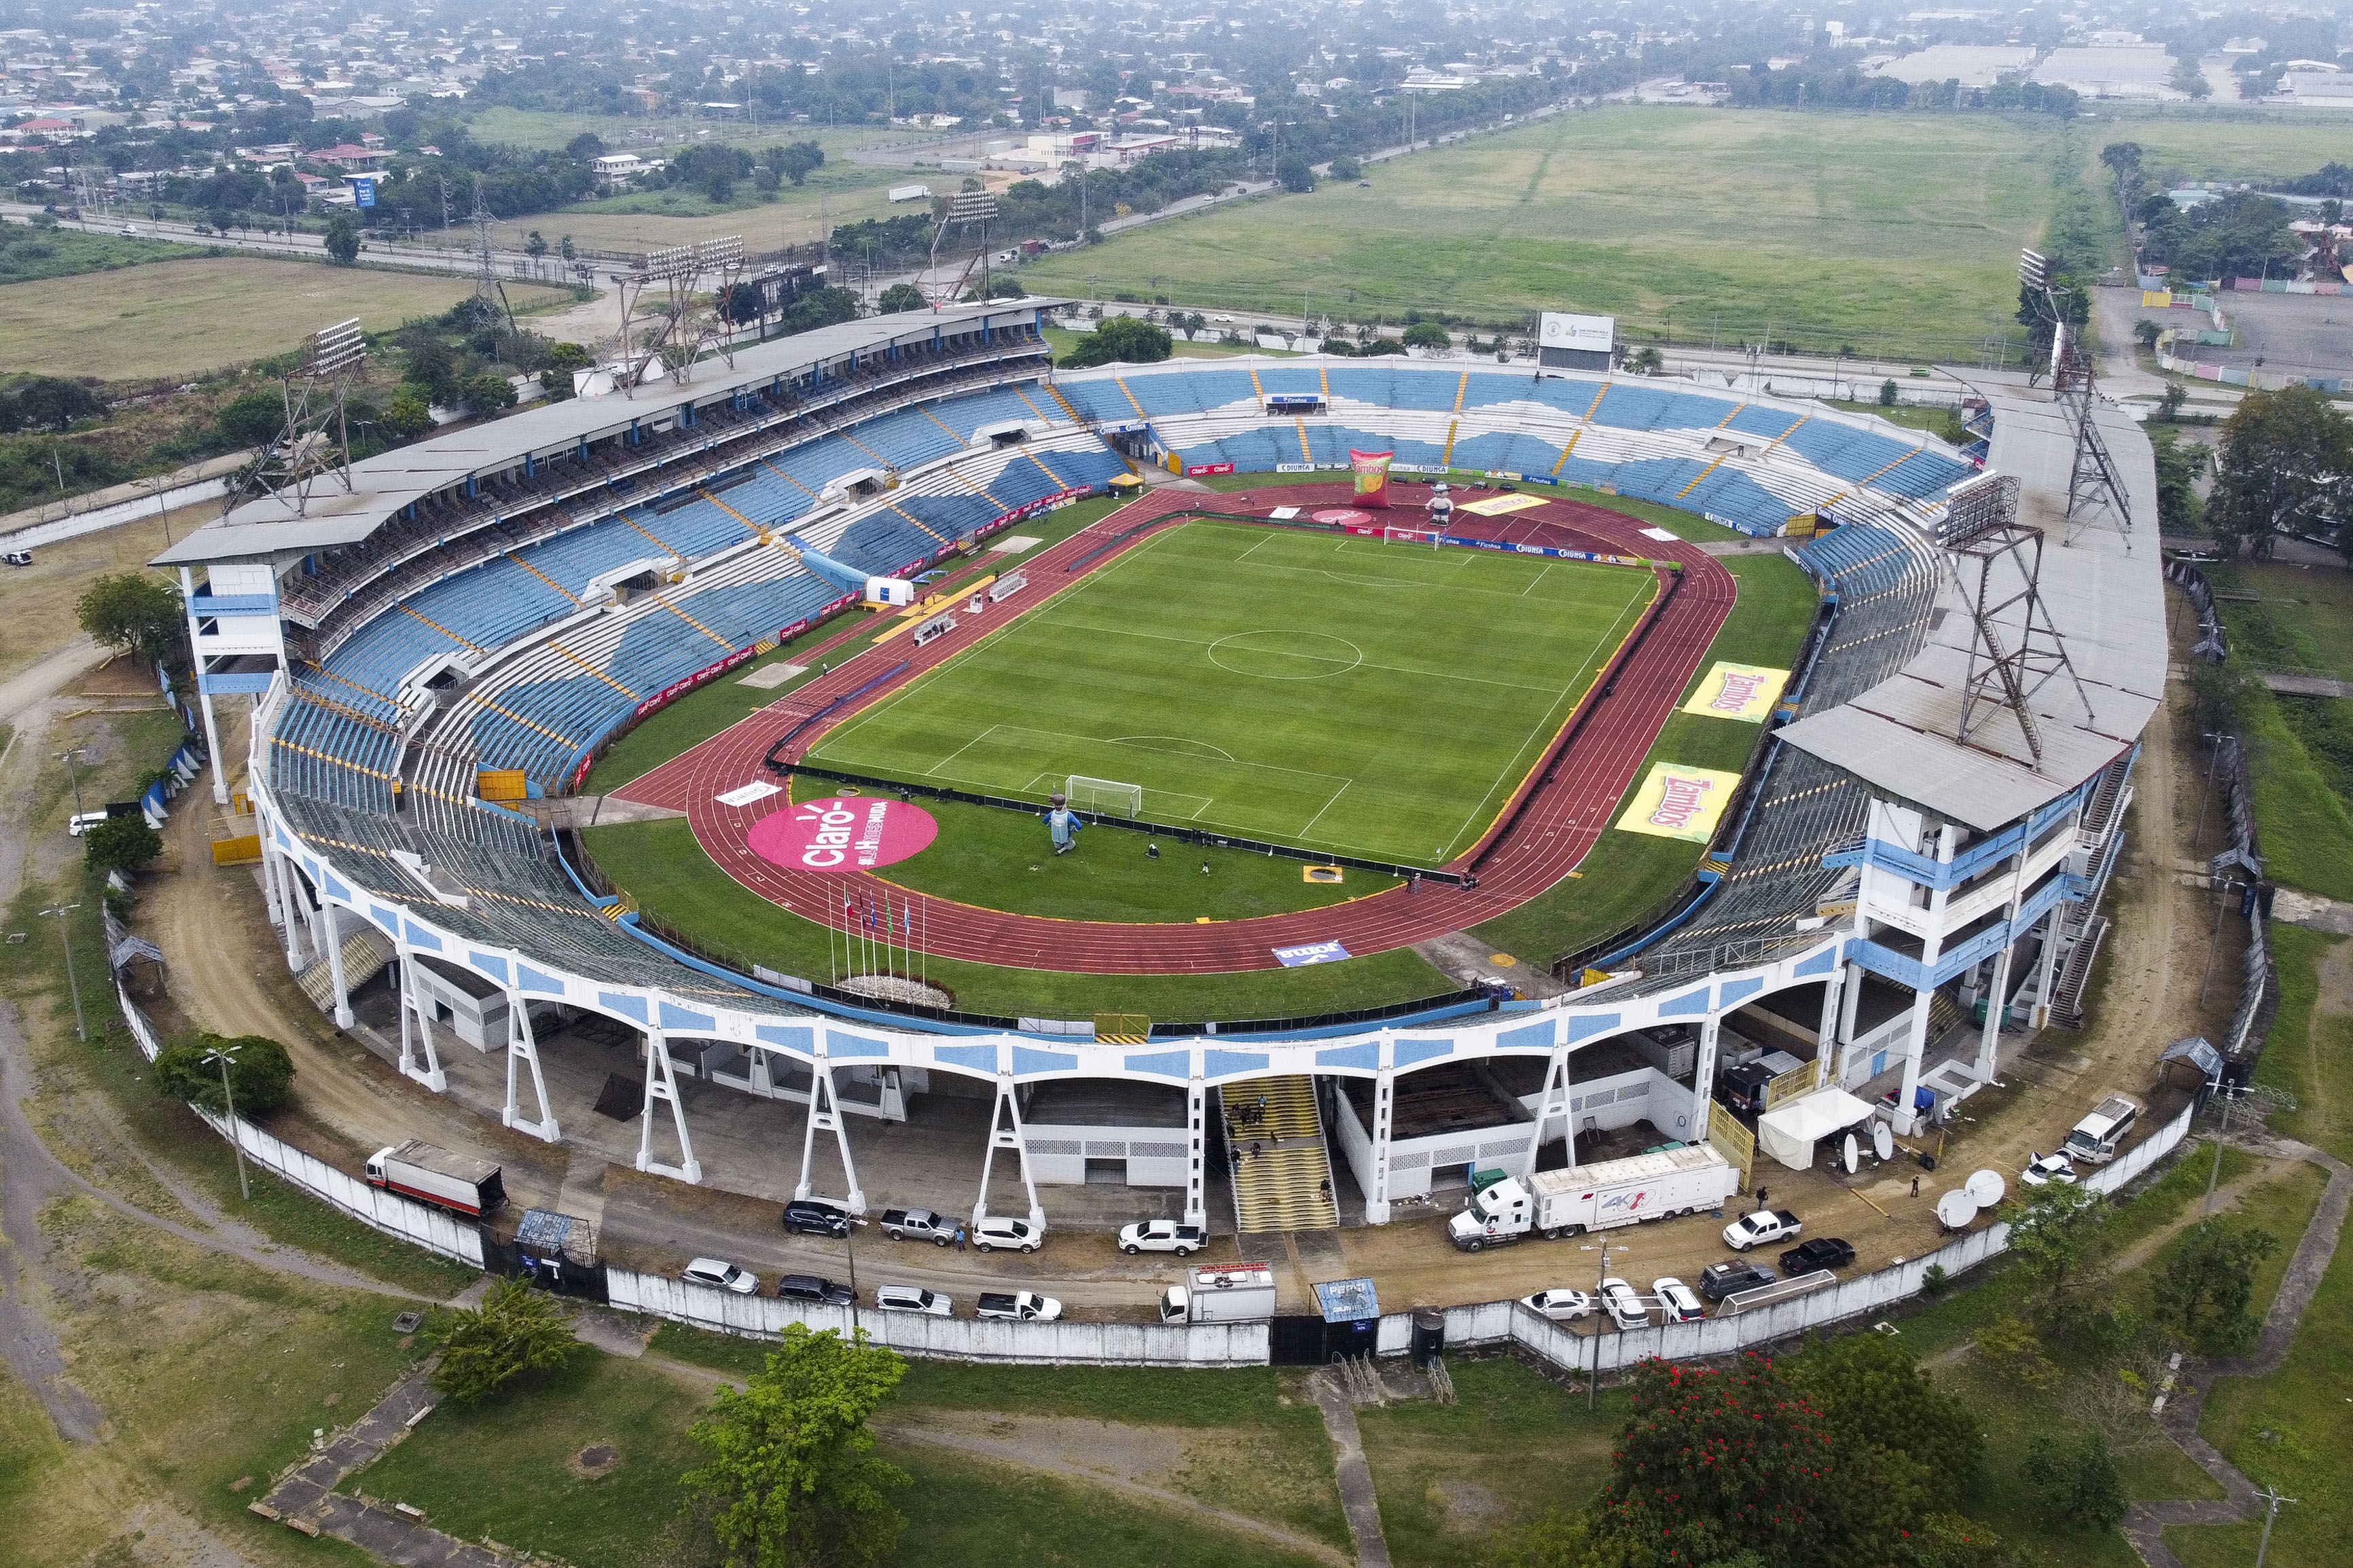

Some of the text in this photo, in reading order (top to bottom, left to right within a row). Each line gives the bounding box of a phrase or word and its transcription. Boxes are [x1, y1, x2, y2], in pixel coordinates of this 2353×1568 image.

[1421, 465, 1446, 473] DIUNSA
[1320, 511, 1362, 522] Claro
[1479, 542, 1501, 550] Ficohsa
[1520, 544, 1586, 560] DIUNSA DIUNSA
[1711, 672, 1767, 713] Zambos
[724, 788, 764, 803] DIUNSA
[1650, 776, 1714, 829] Zambos
[801, 807, 855, 867] Claro
